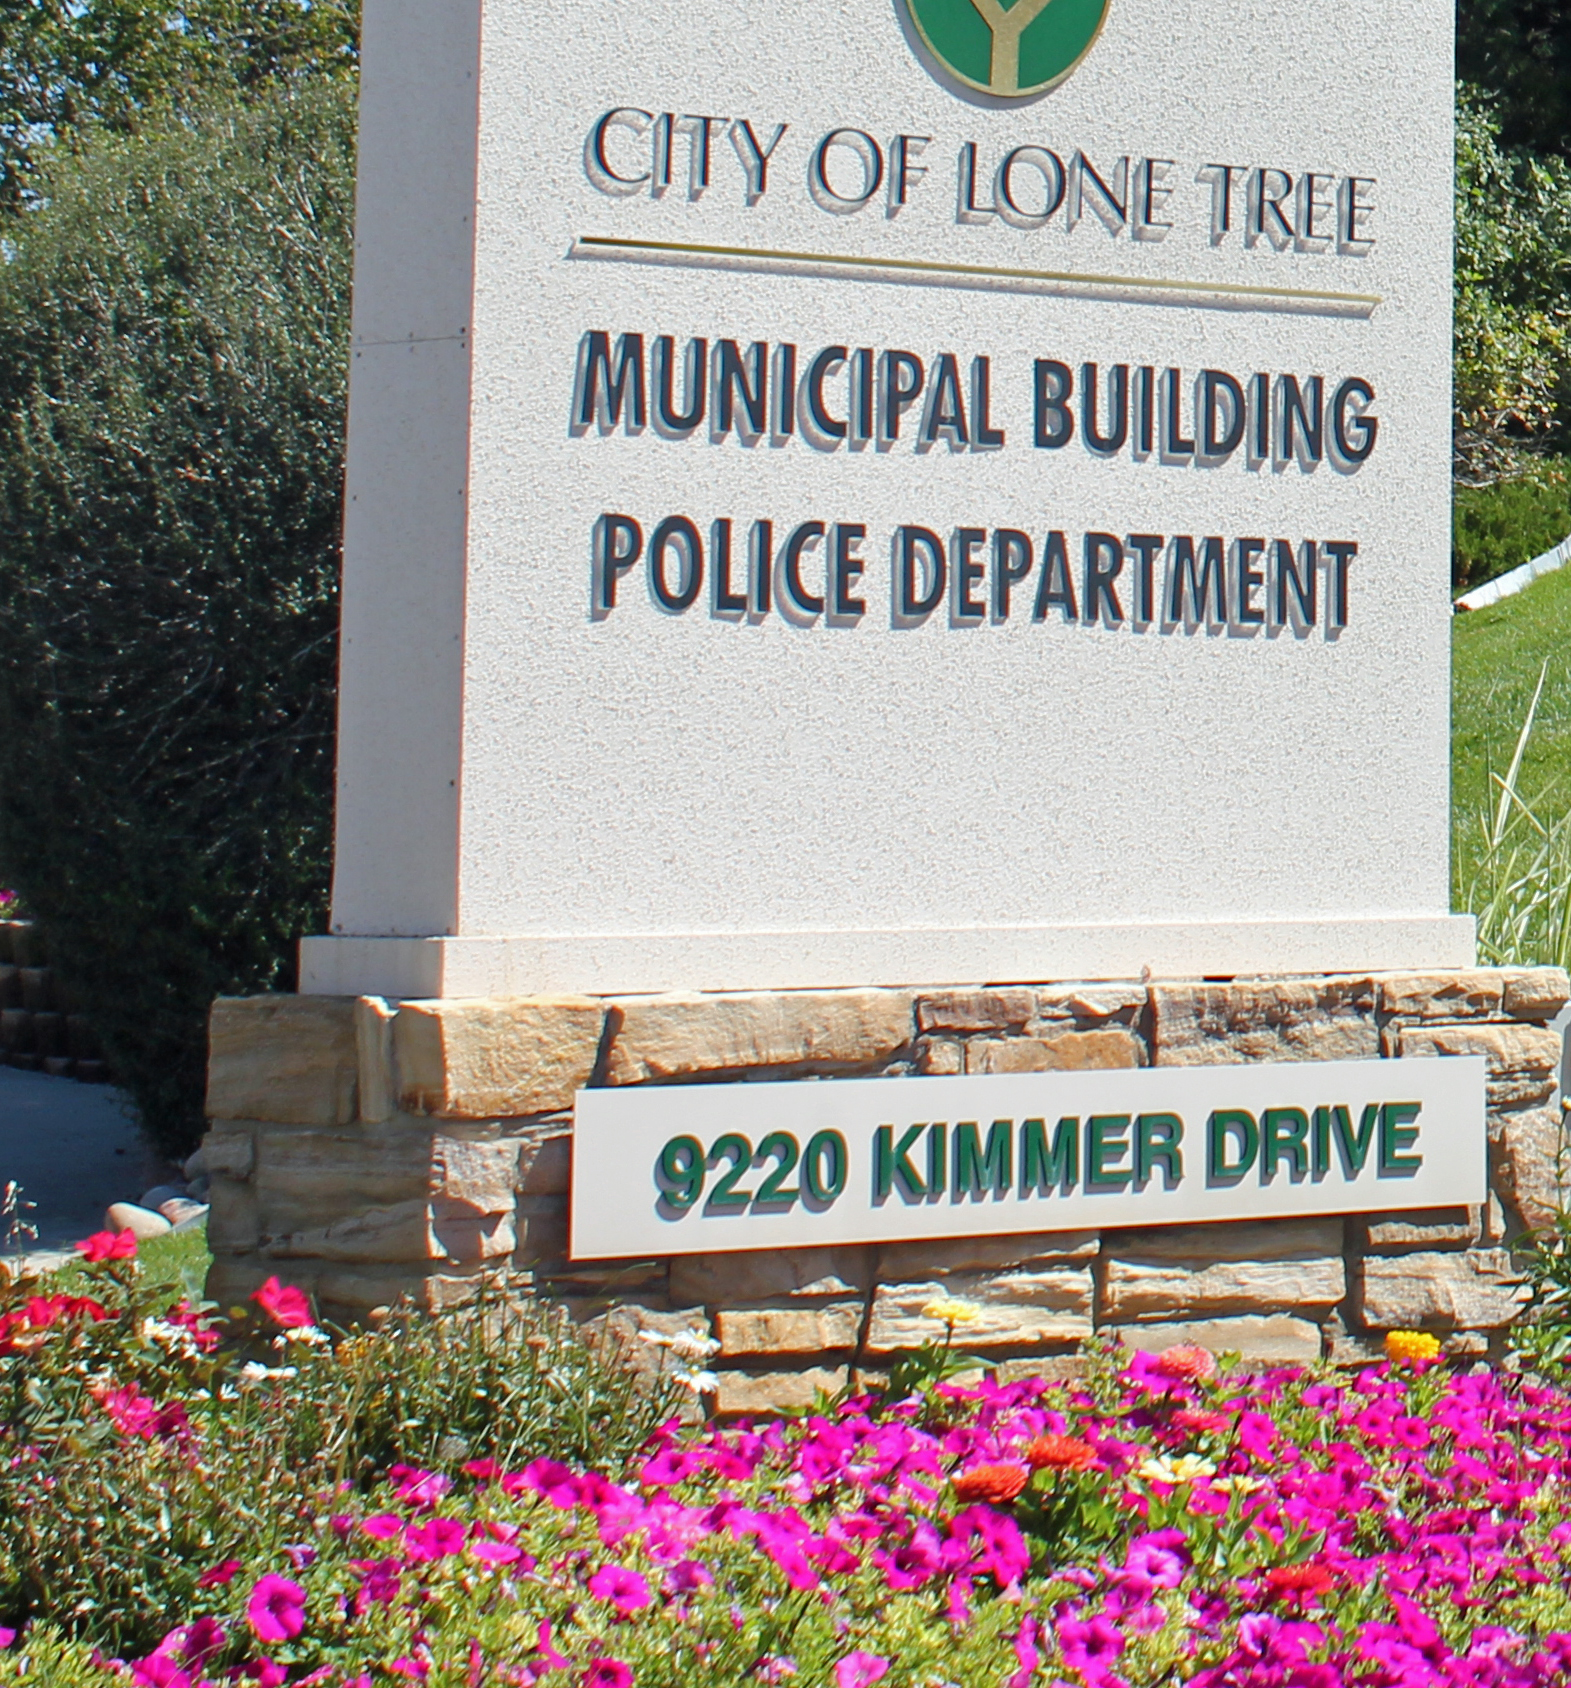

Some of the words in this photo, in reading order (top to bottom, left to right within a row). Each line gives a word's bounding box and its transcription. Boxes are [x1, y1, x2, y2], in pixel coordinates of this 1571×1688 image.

[592, 105, 788, 194] CITY
[815, 126, 932, 205] OF
[962, 140, 1174, 228] LONE
[1205, 162, 1377, 243] TREE
[580, 329, 1005, 447] MUNICIPAL
[1033, 357, 1379, 464] BUILDING
[598, 512, 867, 616] POLICE
[898, 524, 1359, 628] DEPARTMENT
[656, 1128, 848, 1210] 9220
[874, 1112, 1184, 1197] KIMMER
[1208, 1101, 1424, 1179] DRIVE
